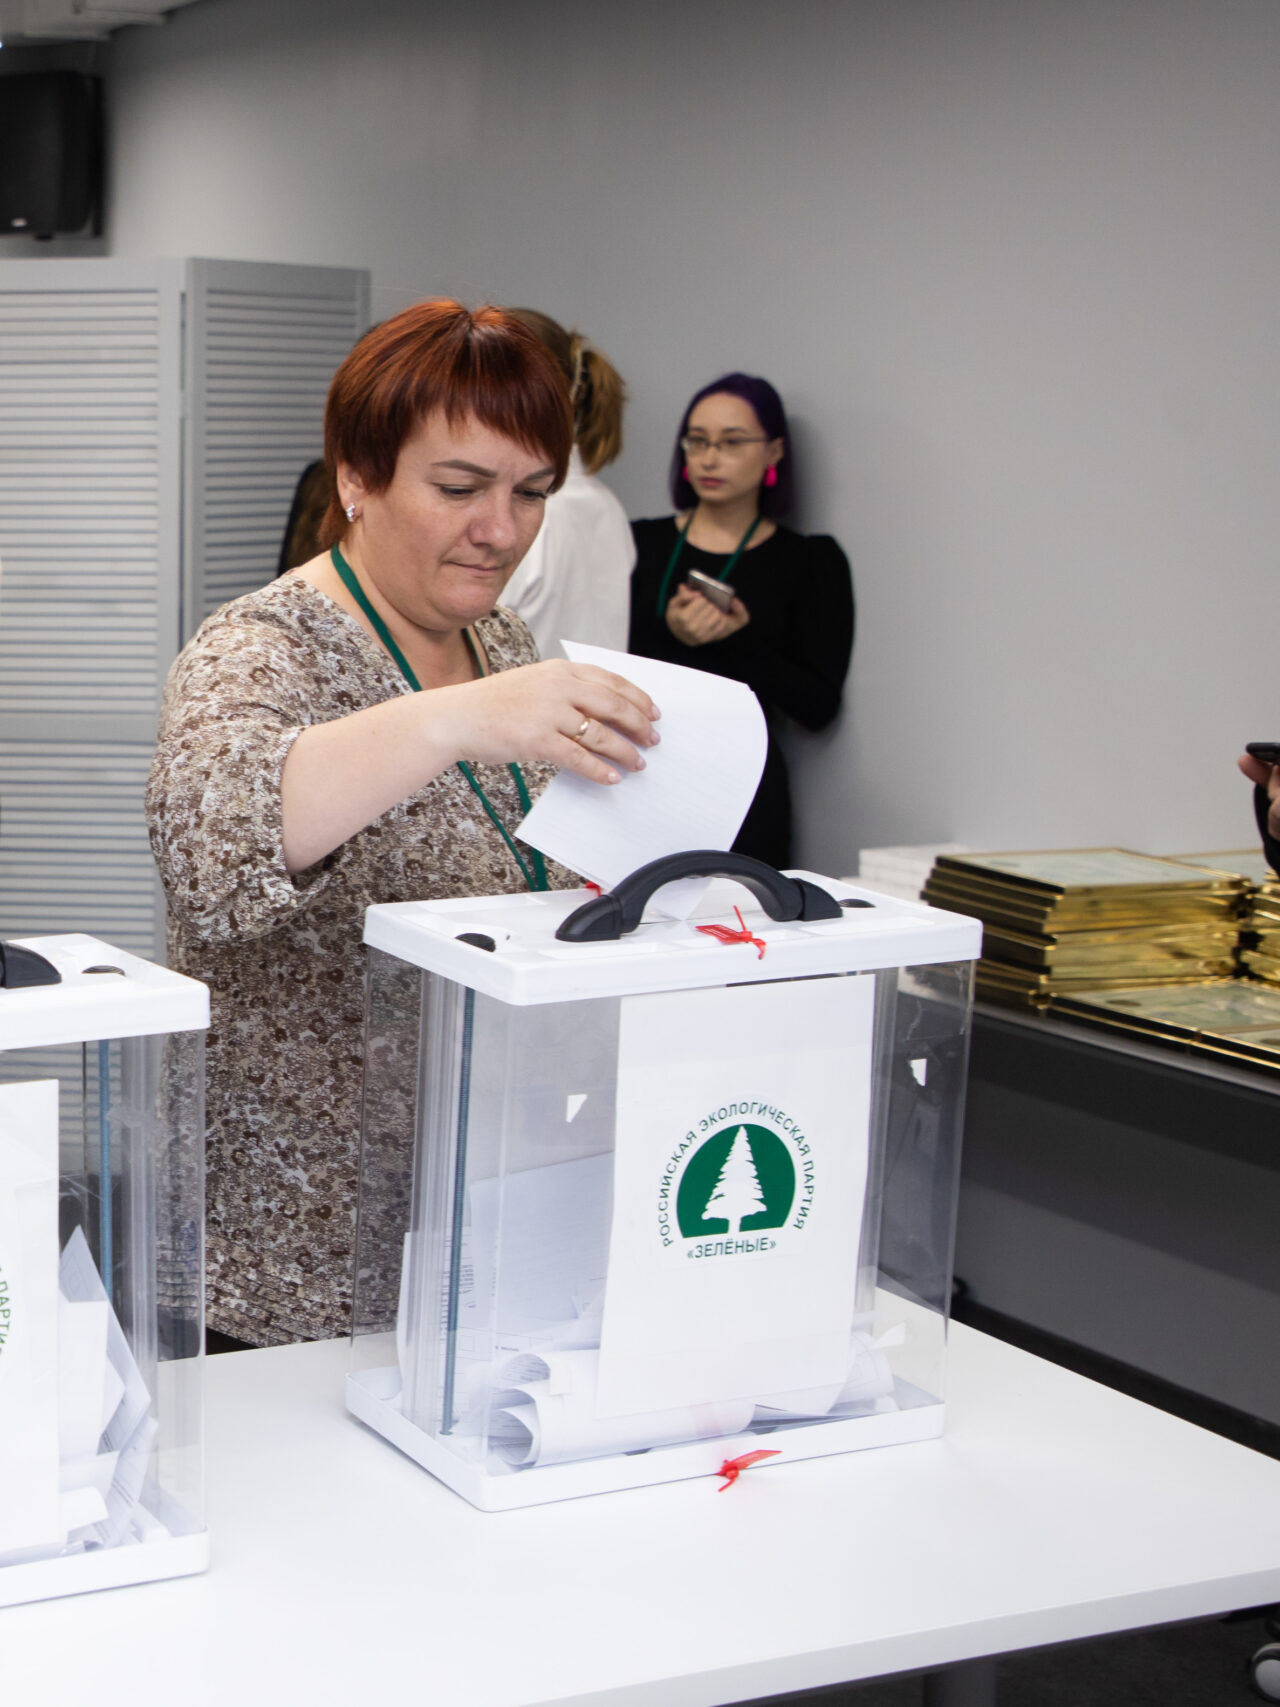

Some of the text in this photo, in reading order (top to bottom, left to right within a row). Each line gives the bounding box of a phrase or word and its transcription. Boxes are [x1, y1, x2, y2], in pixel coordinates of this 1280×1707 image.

[658, 1101, 815, 1247] РОССИЙСКАЯ ЭКОЛОГИЧЕСКАЯ ПАРТИЯ
[687, 1237, 777, 1259] «ЗЕЛЁНЫЕ»
